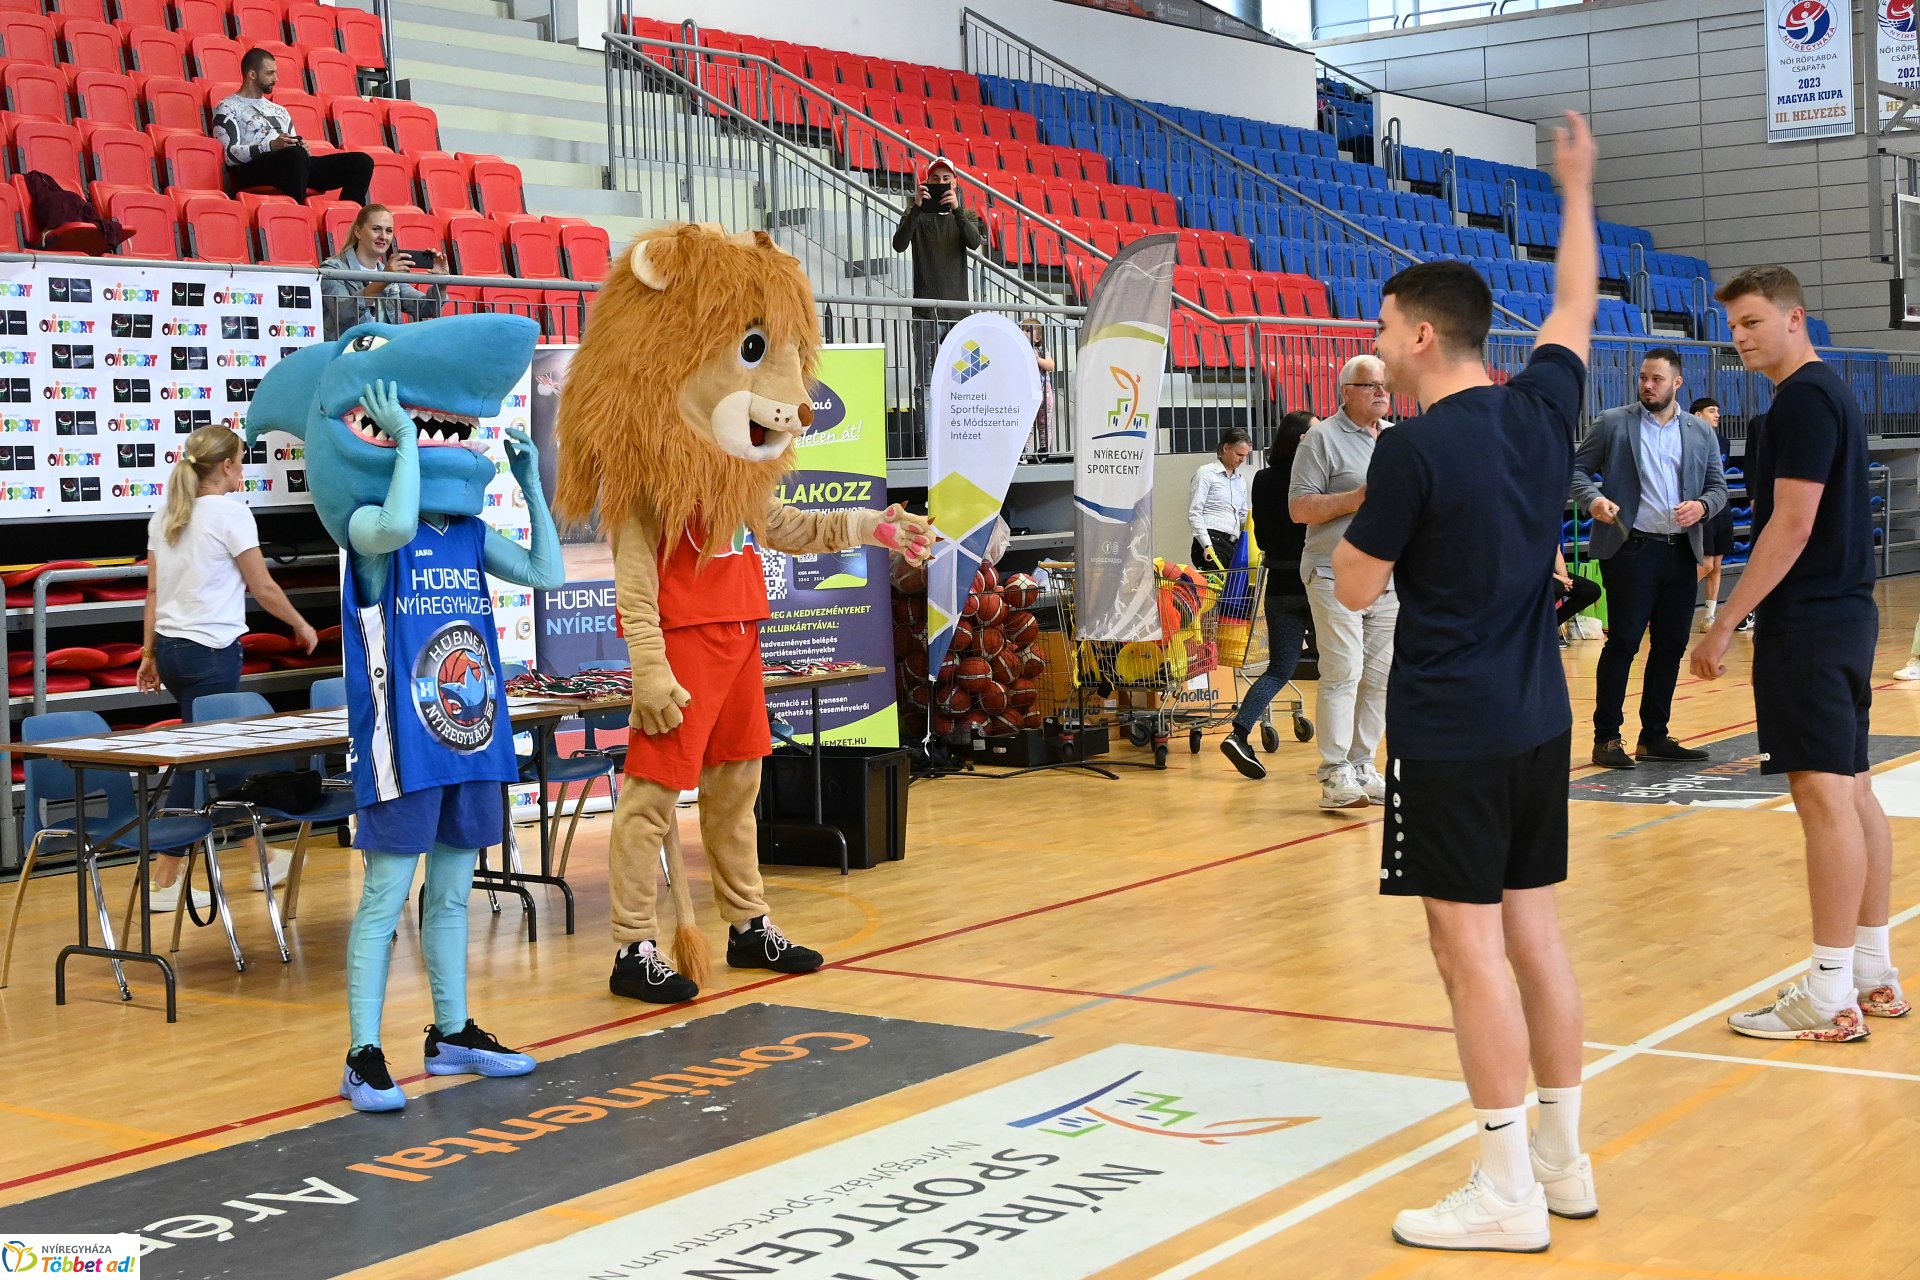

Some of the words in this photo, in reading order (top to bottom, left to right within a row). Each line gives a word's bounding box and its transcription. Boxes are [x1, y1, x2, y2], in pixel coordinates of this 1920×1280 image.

[1896, 44, 1918, 52] RÖPL
[1796, 54, 1838, 64] RÖPLABDA
[1791, 63, 1826, 73] CSAPATA
[1797, 77, 1821, 89] 2023
[1777, 92, 1815, 105] MAGYAR
[1817, 89, 1843, 100] KUPA
[1775, 112, 1790, 124] III.
[1792, 103, 1846, 122] HELYEZÉS
[950, 392, 987, 401] Nemzeti
[950, 404, 1020, 415] Sportfejlesztési
[950, 418, 961, 427] és
[963, 417, 1019, 427] Módszertani
[950, 430, 982, 440] Intézet
[1087, 464, 1140, 475] SPORTCENT
[775, 481, 872, 504] LAKOZZ
[786, 610, 792, 618] A
[793, 605, 871, 617] KEDVEZMÉNYEKET
[767, 620, 840, 633] KLUBKÁRTYÁVAL:
[429, 630, 486, 663] HÜBNER
[760, 638, 811, 648] kedvezményes
[812, 636, 838, 645] belépés
[760, 646, 836, 658] sportlétesítményekbe
[425, 703, 491, 746] NYÍREGYHÁZA
[345, 1030, 871, 1182] Continental
[825, 1140, 983, 1196] Nyíregyházi
[619, 1193, 835, 1270] Sportcentrum
